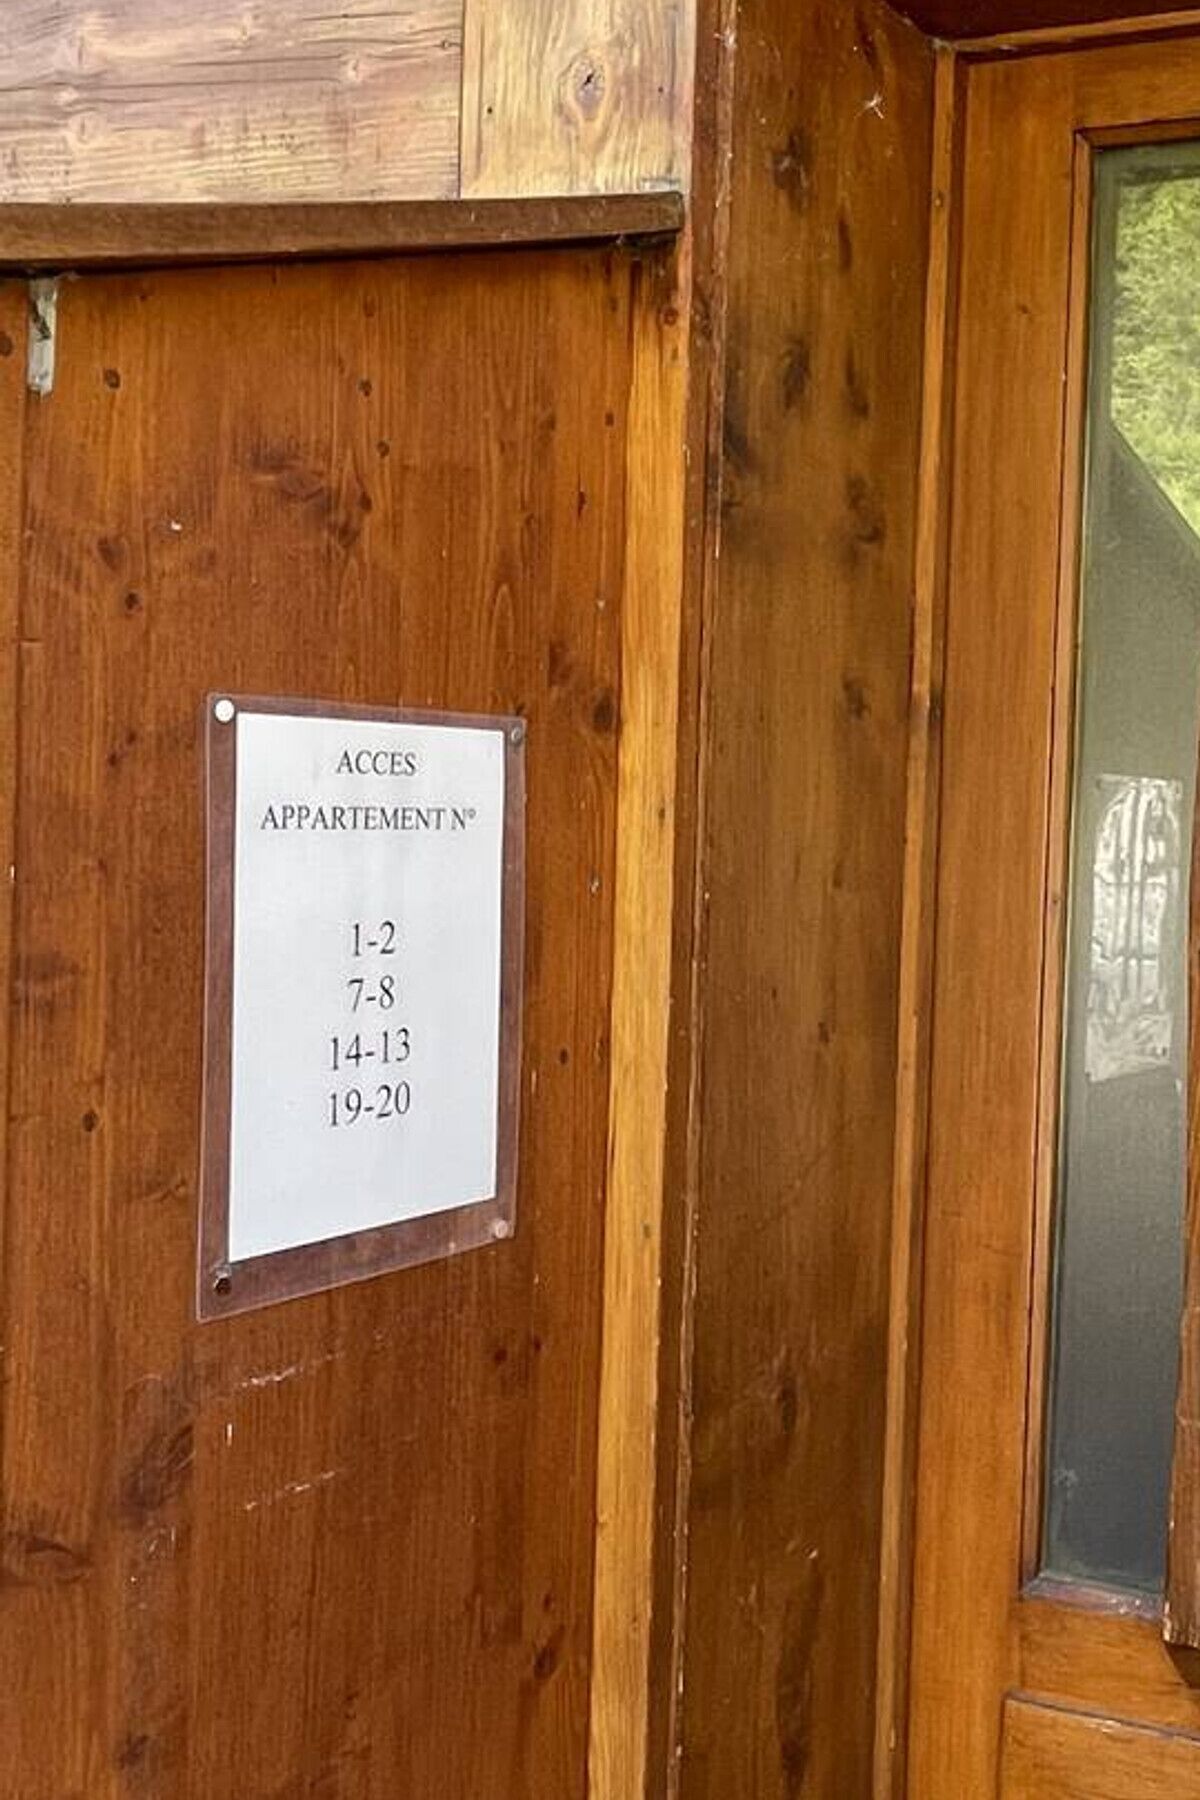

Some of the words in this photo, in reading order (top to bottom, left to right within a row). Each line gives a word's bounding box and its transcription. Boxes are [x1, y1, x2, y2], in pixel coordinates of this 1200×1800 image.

[336, 750, 417, 775] ACCES
[260, 804, 446, 831] APPARTEMENT
[351, 920, 396, 957] 1-2
[347, 975, 396, 1012] 7-8
[331, 1027, 411, 1071] 14-13
[329, 1080, 411, 1127] 19-20
